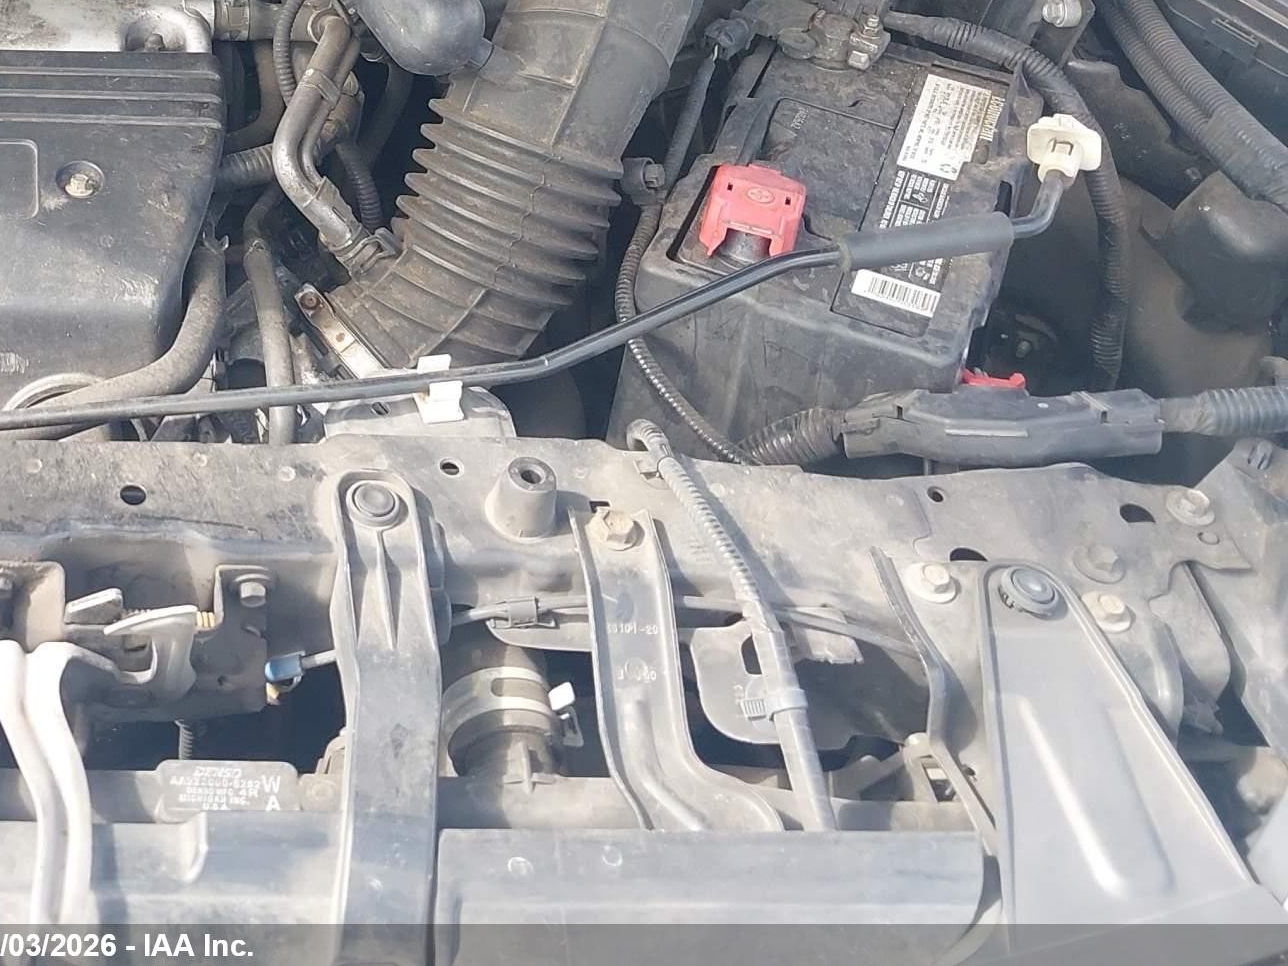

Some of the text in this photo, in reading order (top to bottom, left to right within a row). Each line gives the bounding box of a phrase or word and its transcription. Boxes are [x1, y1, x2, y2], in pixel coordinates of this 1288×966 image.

[192, 766, 243, 778] DENSO
[261, 775, 281, 794] W
[265, 795, 281, 811] A
